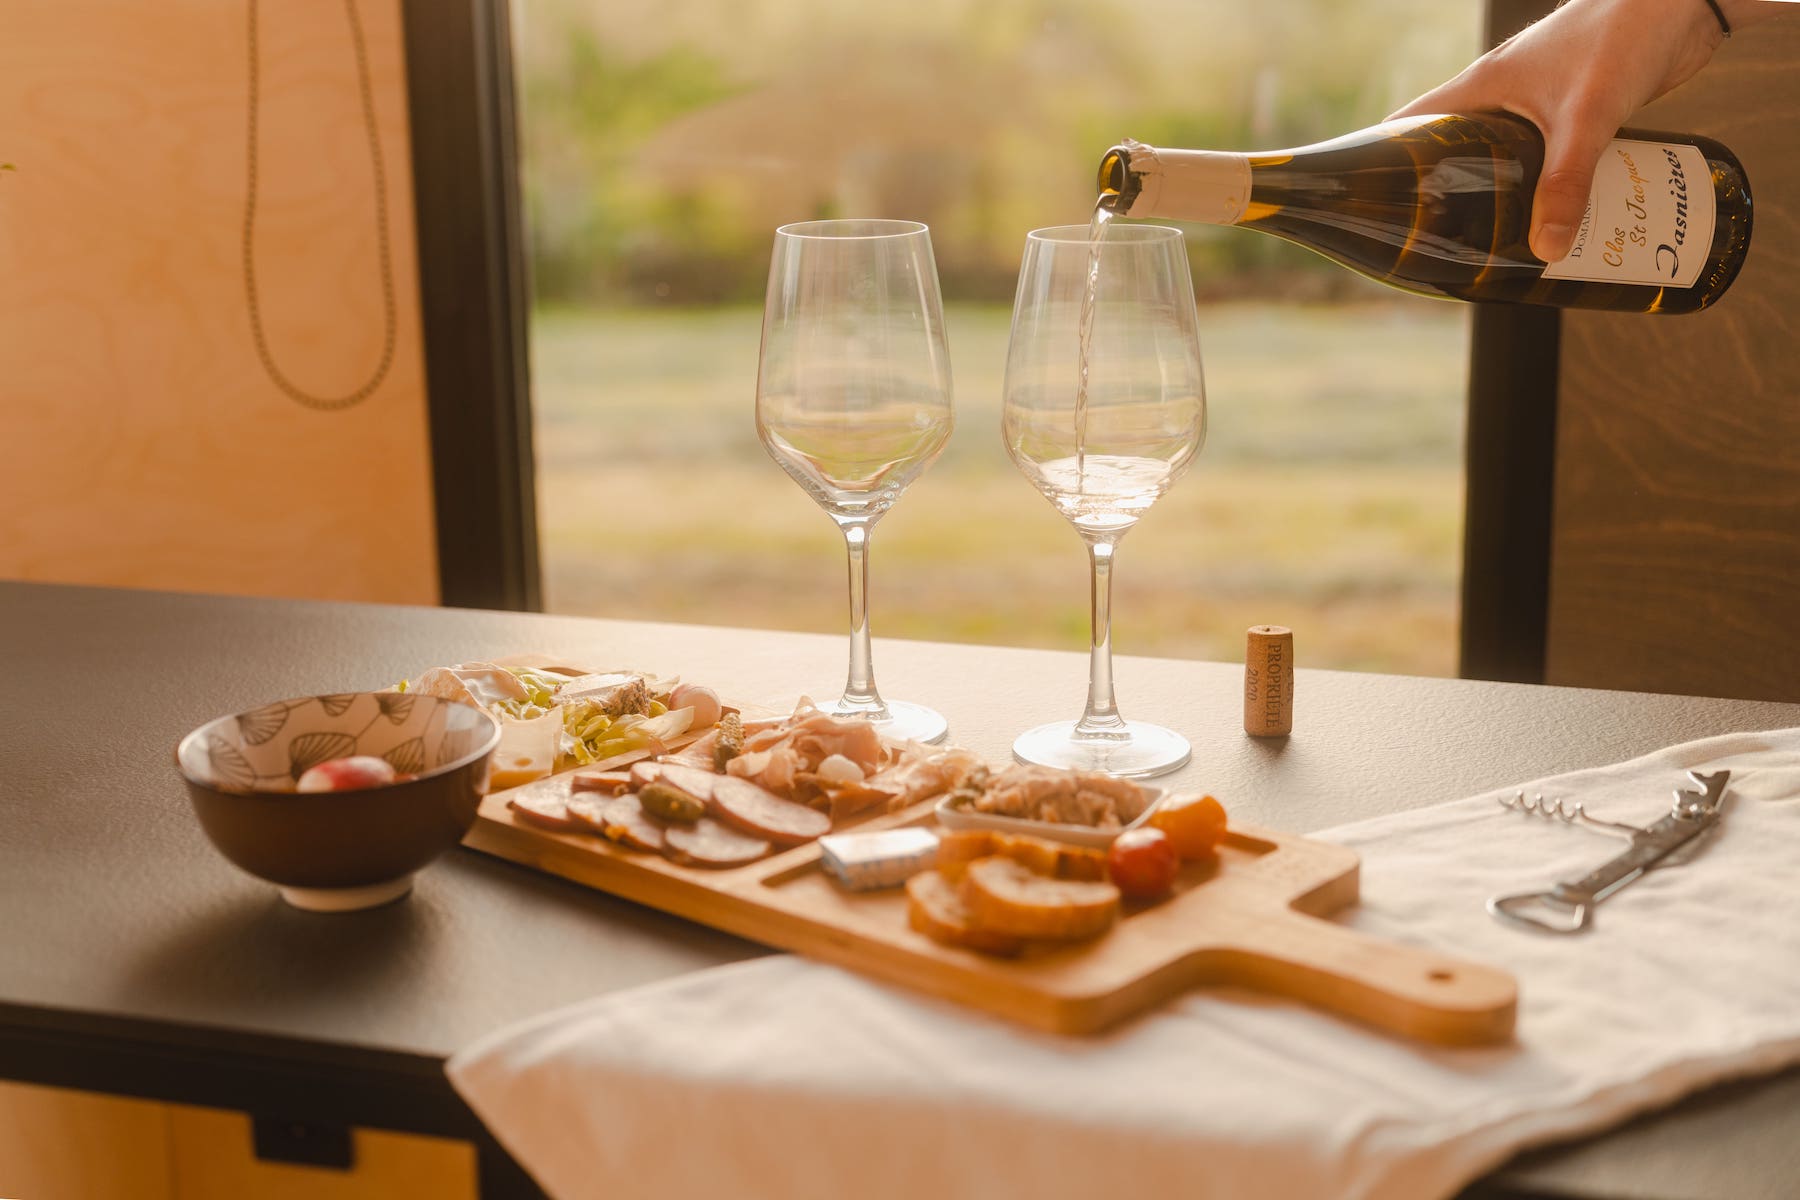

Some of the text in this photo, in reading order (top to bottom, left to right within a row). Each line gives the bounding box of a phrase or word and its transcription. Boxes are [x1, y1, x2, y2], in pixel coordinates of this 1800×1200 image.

[1617, 149, 1650, 247] St Jacques
[1655, 148, 1689, 279] Jasnières
[1602, 227, 1626, 268] Clos
